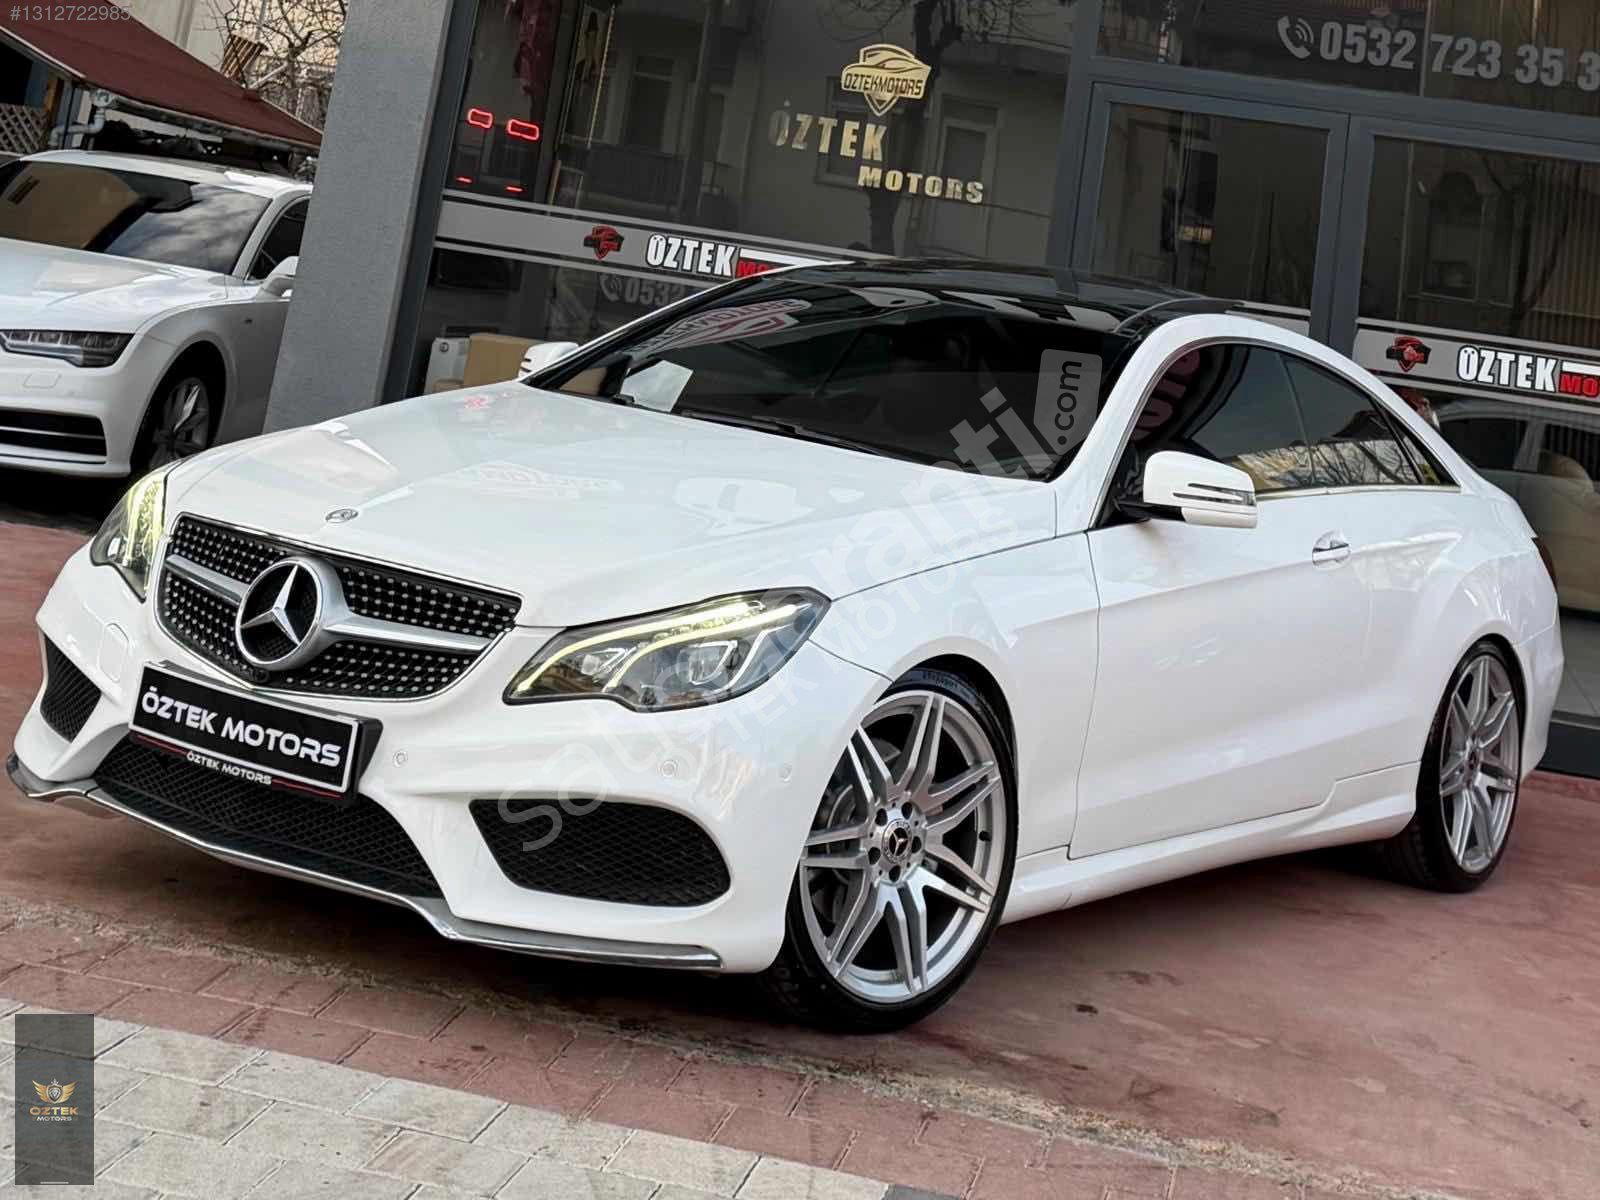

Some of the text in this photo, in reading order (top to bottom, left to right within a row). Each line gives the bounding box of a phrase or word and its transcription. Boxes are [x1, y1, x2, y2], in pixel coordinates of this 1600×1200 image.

[1319, 21, 1416, 70] 0532
[1430, 33, 1501, 80] 723
[1515, 44, 1564, 87] 35
[857, 165, 984, 203] MOTORS
[141, 686, 341, 768] ÖZTEK MOTORS
[221, 763, 272, 785] MOTORS
